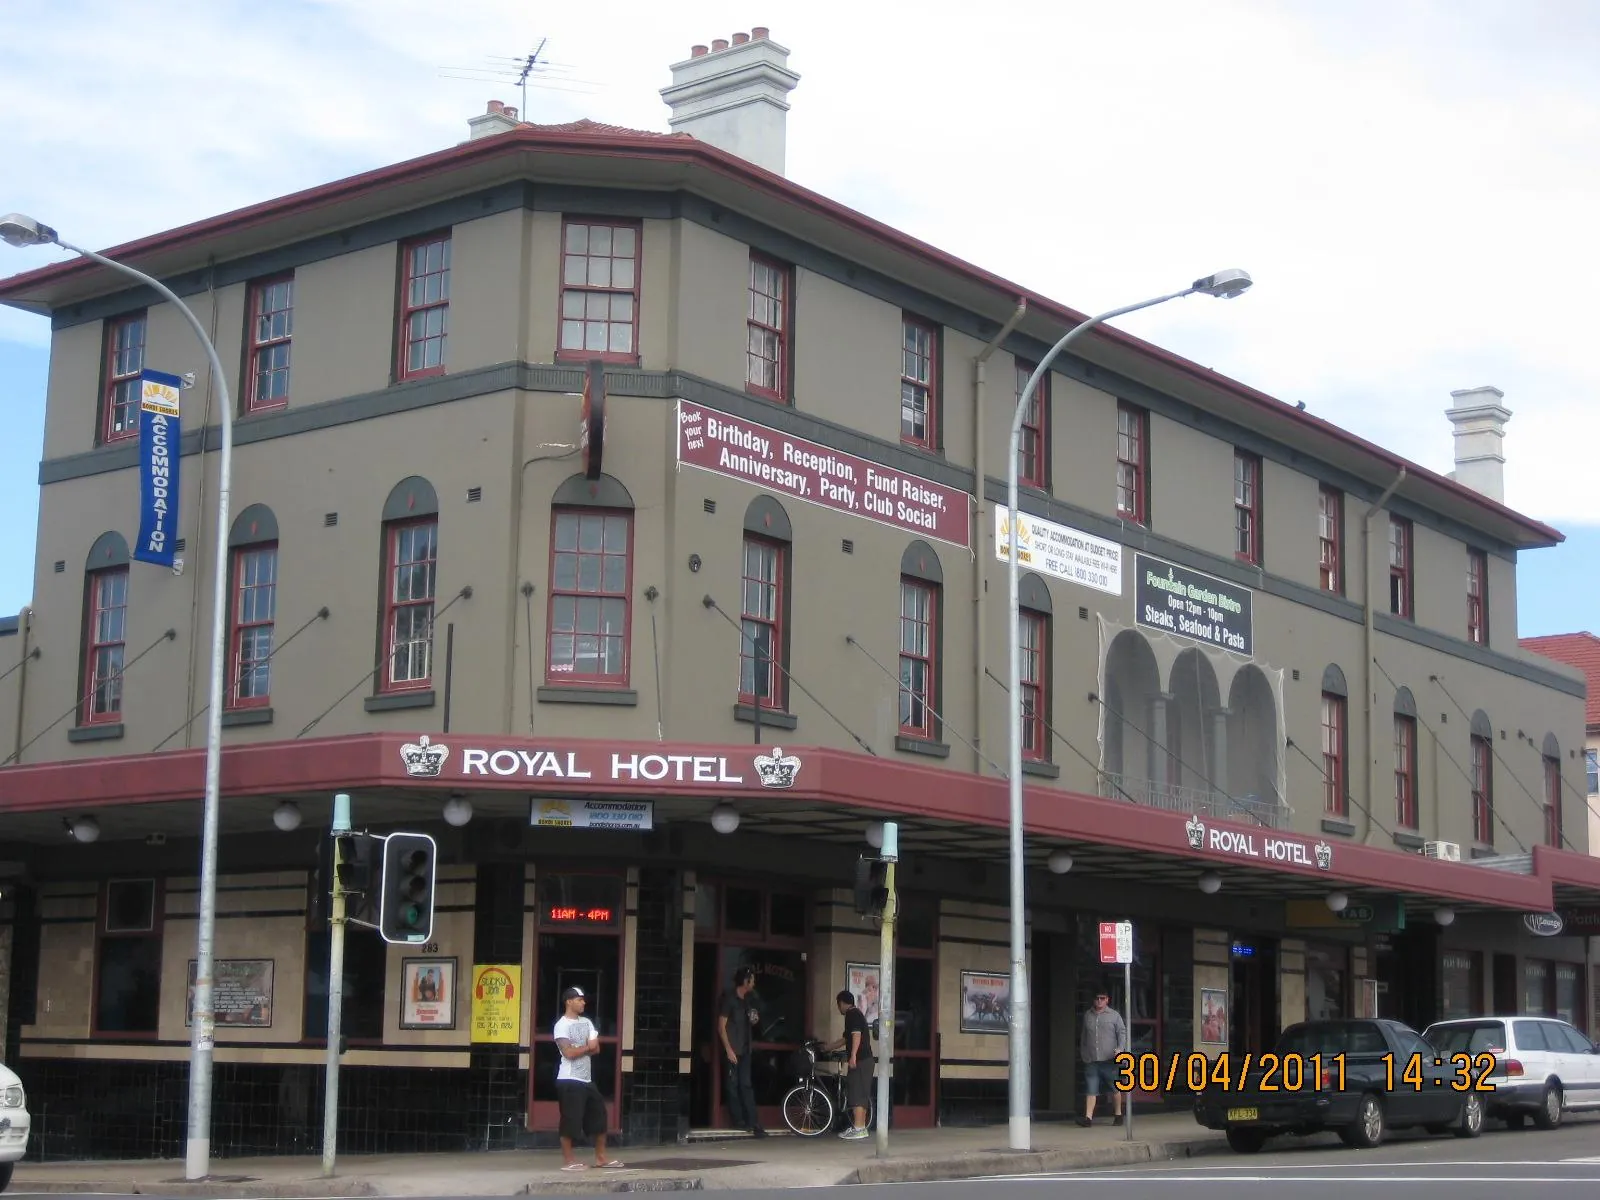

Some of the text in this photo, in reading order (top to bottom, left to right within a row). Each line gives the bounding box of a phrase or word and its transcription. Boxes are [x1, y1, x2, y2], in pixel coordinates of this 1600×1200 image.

[681, 411, 702, 424] Book
[685, 426, 702, 440] your
[687, 437, 704, 450] next
[707, 417, 947, 513] Birthday, Reception, Fund Raiser,
[149, 414, 169, 553] ACCOMMODATION
[720, 447, 937, 530] Anniversary, Party, Club Social
[1032, 524, 1050, 540] QUALITY
[1045, 558, 1058, 572] FREE
[1060, 562, 1074, 577] CALL
[1147, 568, 1241, 614] Fountain Garden Bistro
[1168, 594, 1184, 610] Open
[1185, 600, 1202, 616] 12pm
[1207, 607, 1224, 623] 10pm
[1145, 605, 1245, 650] Steaks, Seafood & Pasta
[462, 749, 743, 784] ROYAL HOTEL
[584, 801, 647, 811] Accommodation
[1209, 828, 1312, 865] ROYAL HOTEL
[551, 908, 576, 919] 11AM
[587, 910, 609, 921] 4PM
[1125, 926, 1130, 935] P
[422, 944, 439, 953] 283
